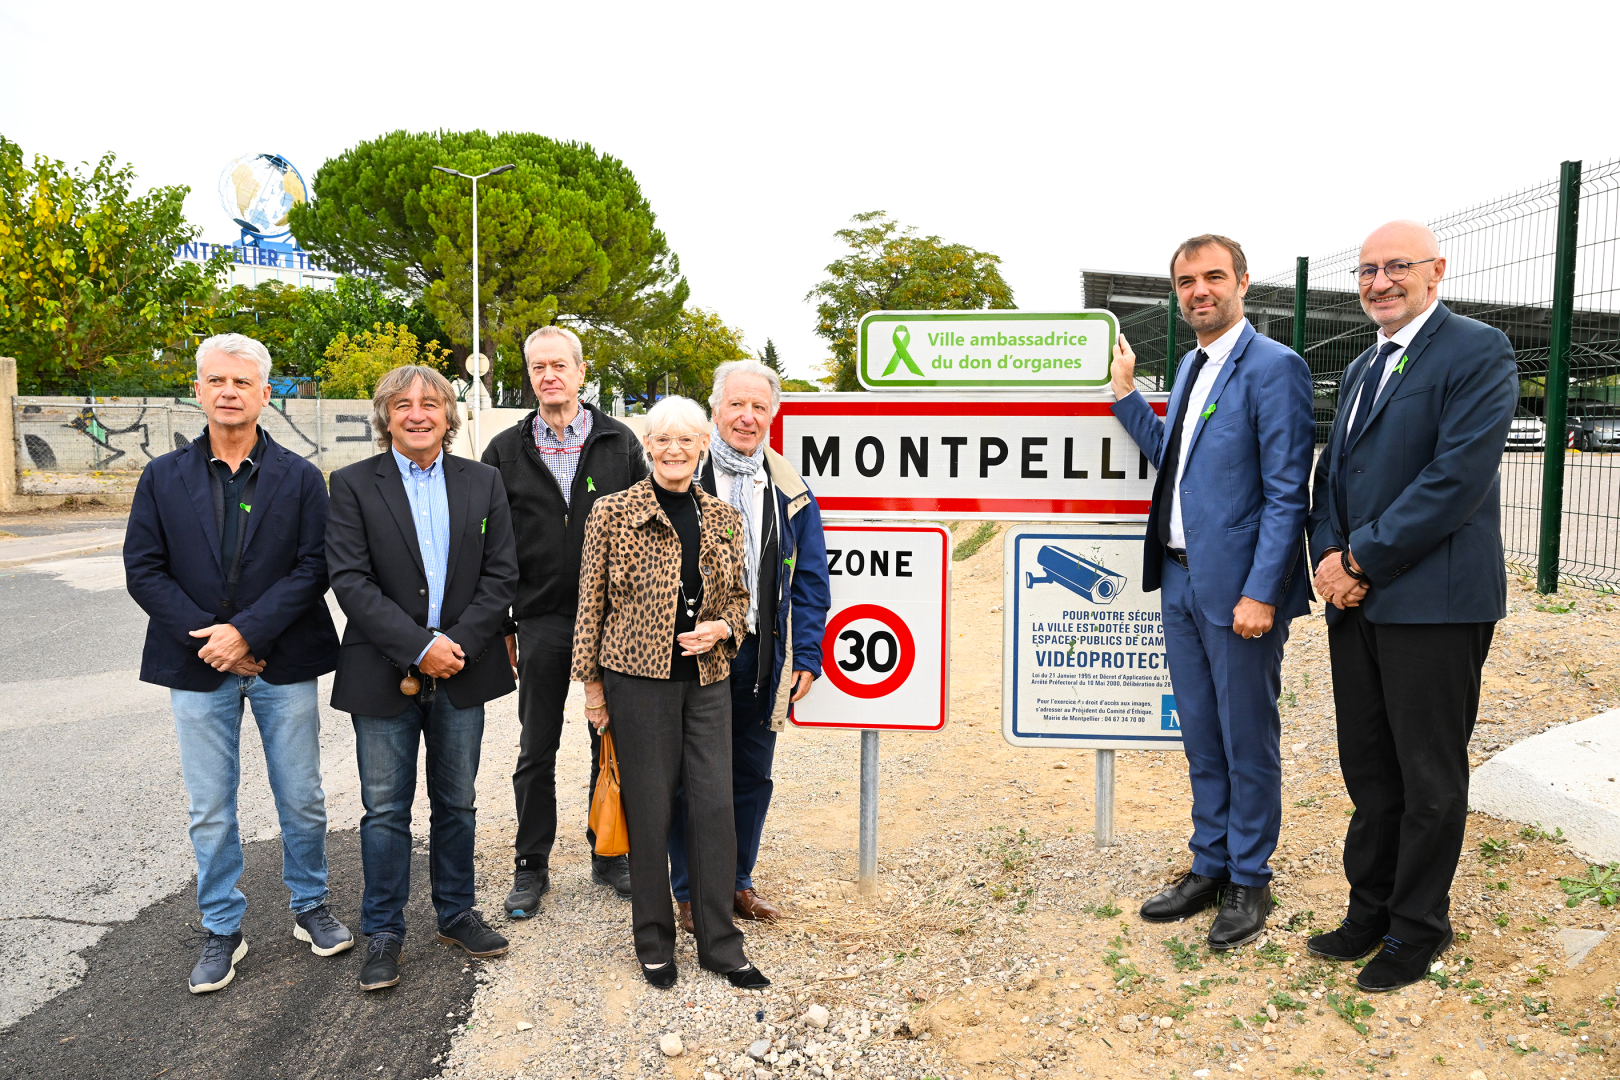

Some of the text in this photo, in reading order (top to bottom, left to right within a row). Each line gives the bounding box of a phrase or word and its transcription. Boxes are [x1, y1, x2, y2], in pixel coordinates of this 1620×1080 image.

[927, 331, 1087, 347] Ville ambassadrice
[931, 355, 956, 369] du
[960, 355, 993, 369] don
[826, 550, 912, 577] ZONE
[1063, 611, 1089, 620] POUR
[1093, 611, 1124, 620] VOTRE
[1033, 623, 1044, 631] LA
[1048, 623, 1073, 632] VILLE
[1077, 624, 1095, 632] EST
[1099, 622, 1130, 633] DOTÉE
[1134, 624, 1154, 633] SUR
[1032, 635, 1077, 644] ESPACES
[1080, 636, 1122, 645] PUBLICS
[1126, 637, 1138, 645] DE
[838, 630, 897, 672] 30
